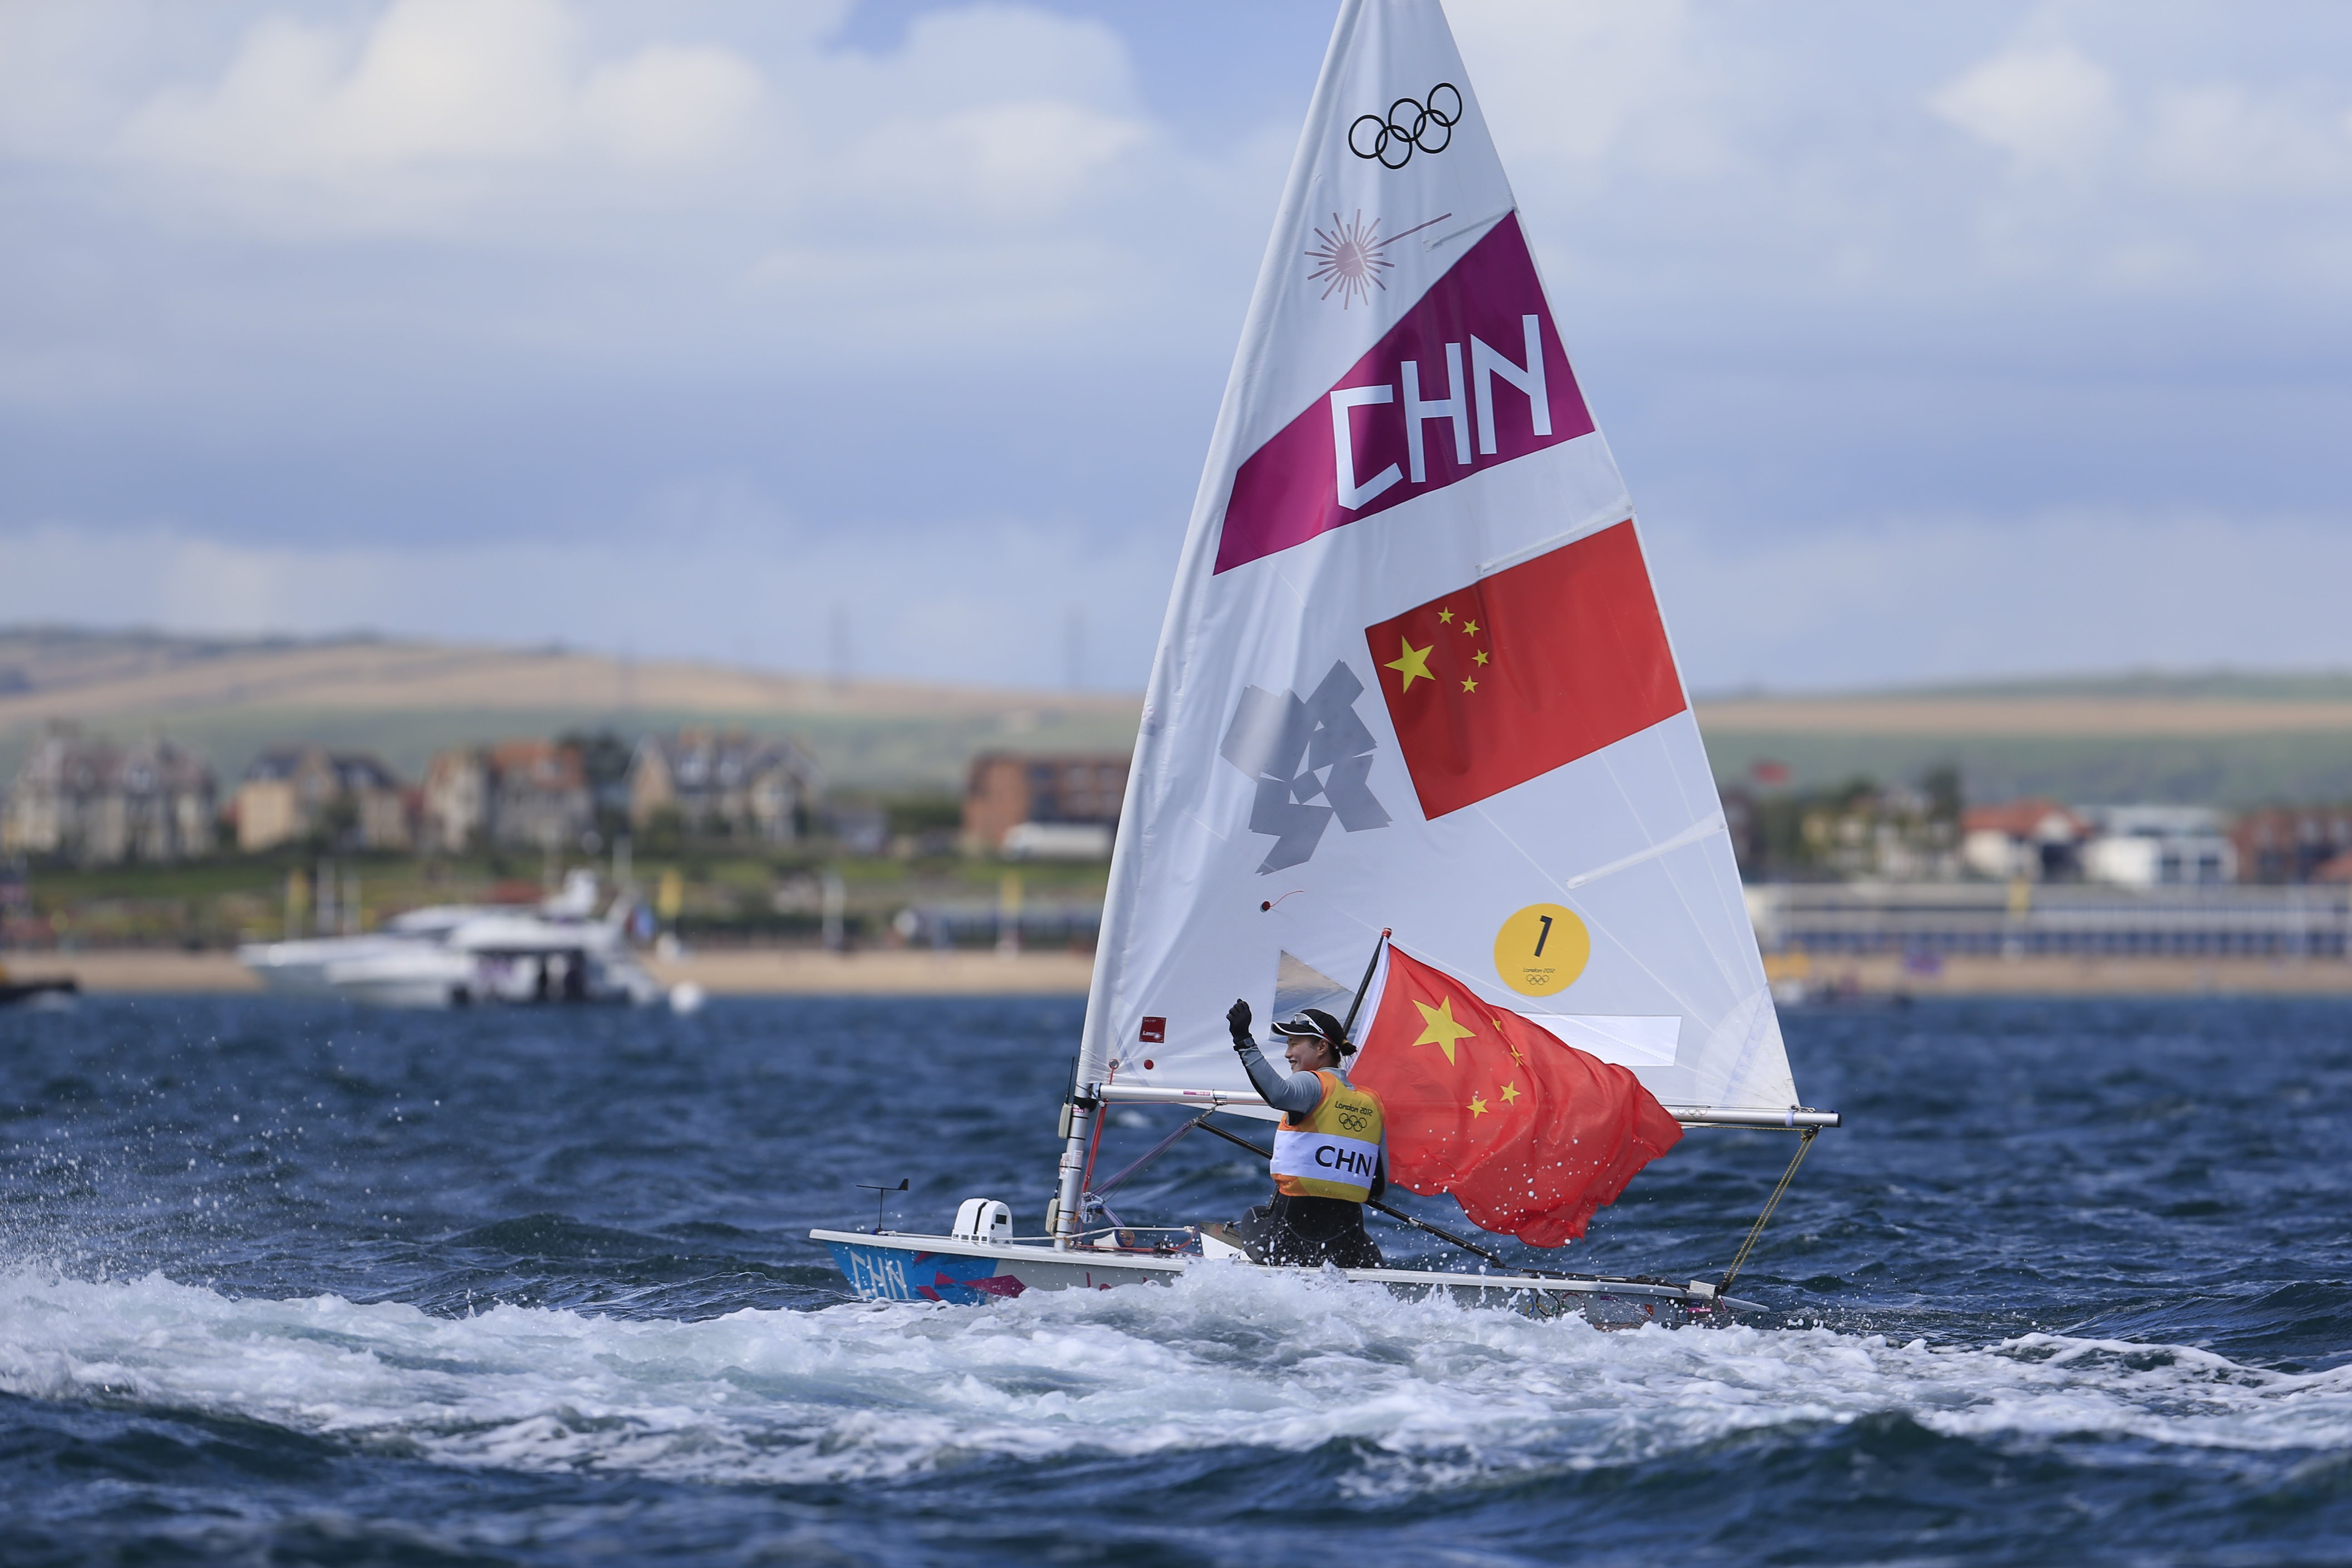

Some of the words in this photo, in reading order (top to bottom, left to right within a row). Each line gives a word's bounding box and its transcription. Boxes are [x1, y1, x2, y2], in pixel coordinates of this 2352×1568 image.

[1330, 314, 1552, 510] CHN
[1534, 915, 1553, 957] 1
[1335, 1101, 1358, 1113] London
[1360, 1107, 1373, 1117] 2012
[1315, 1145, 1372, 1177] CHN
[850, 1250, 909, 1299] CHN
